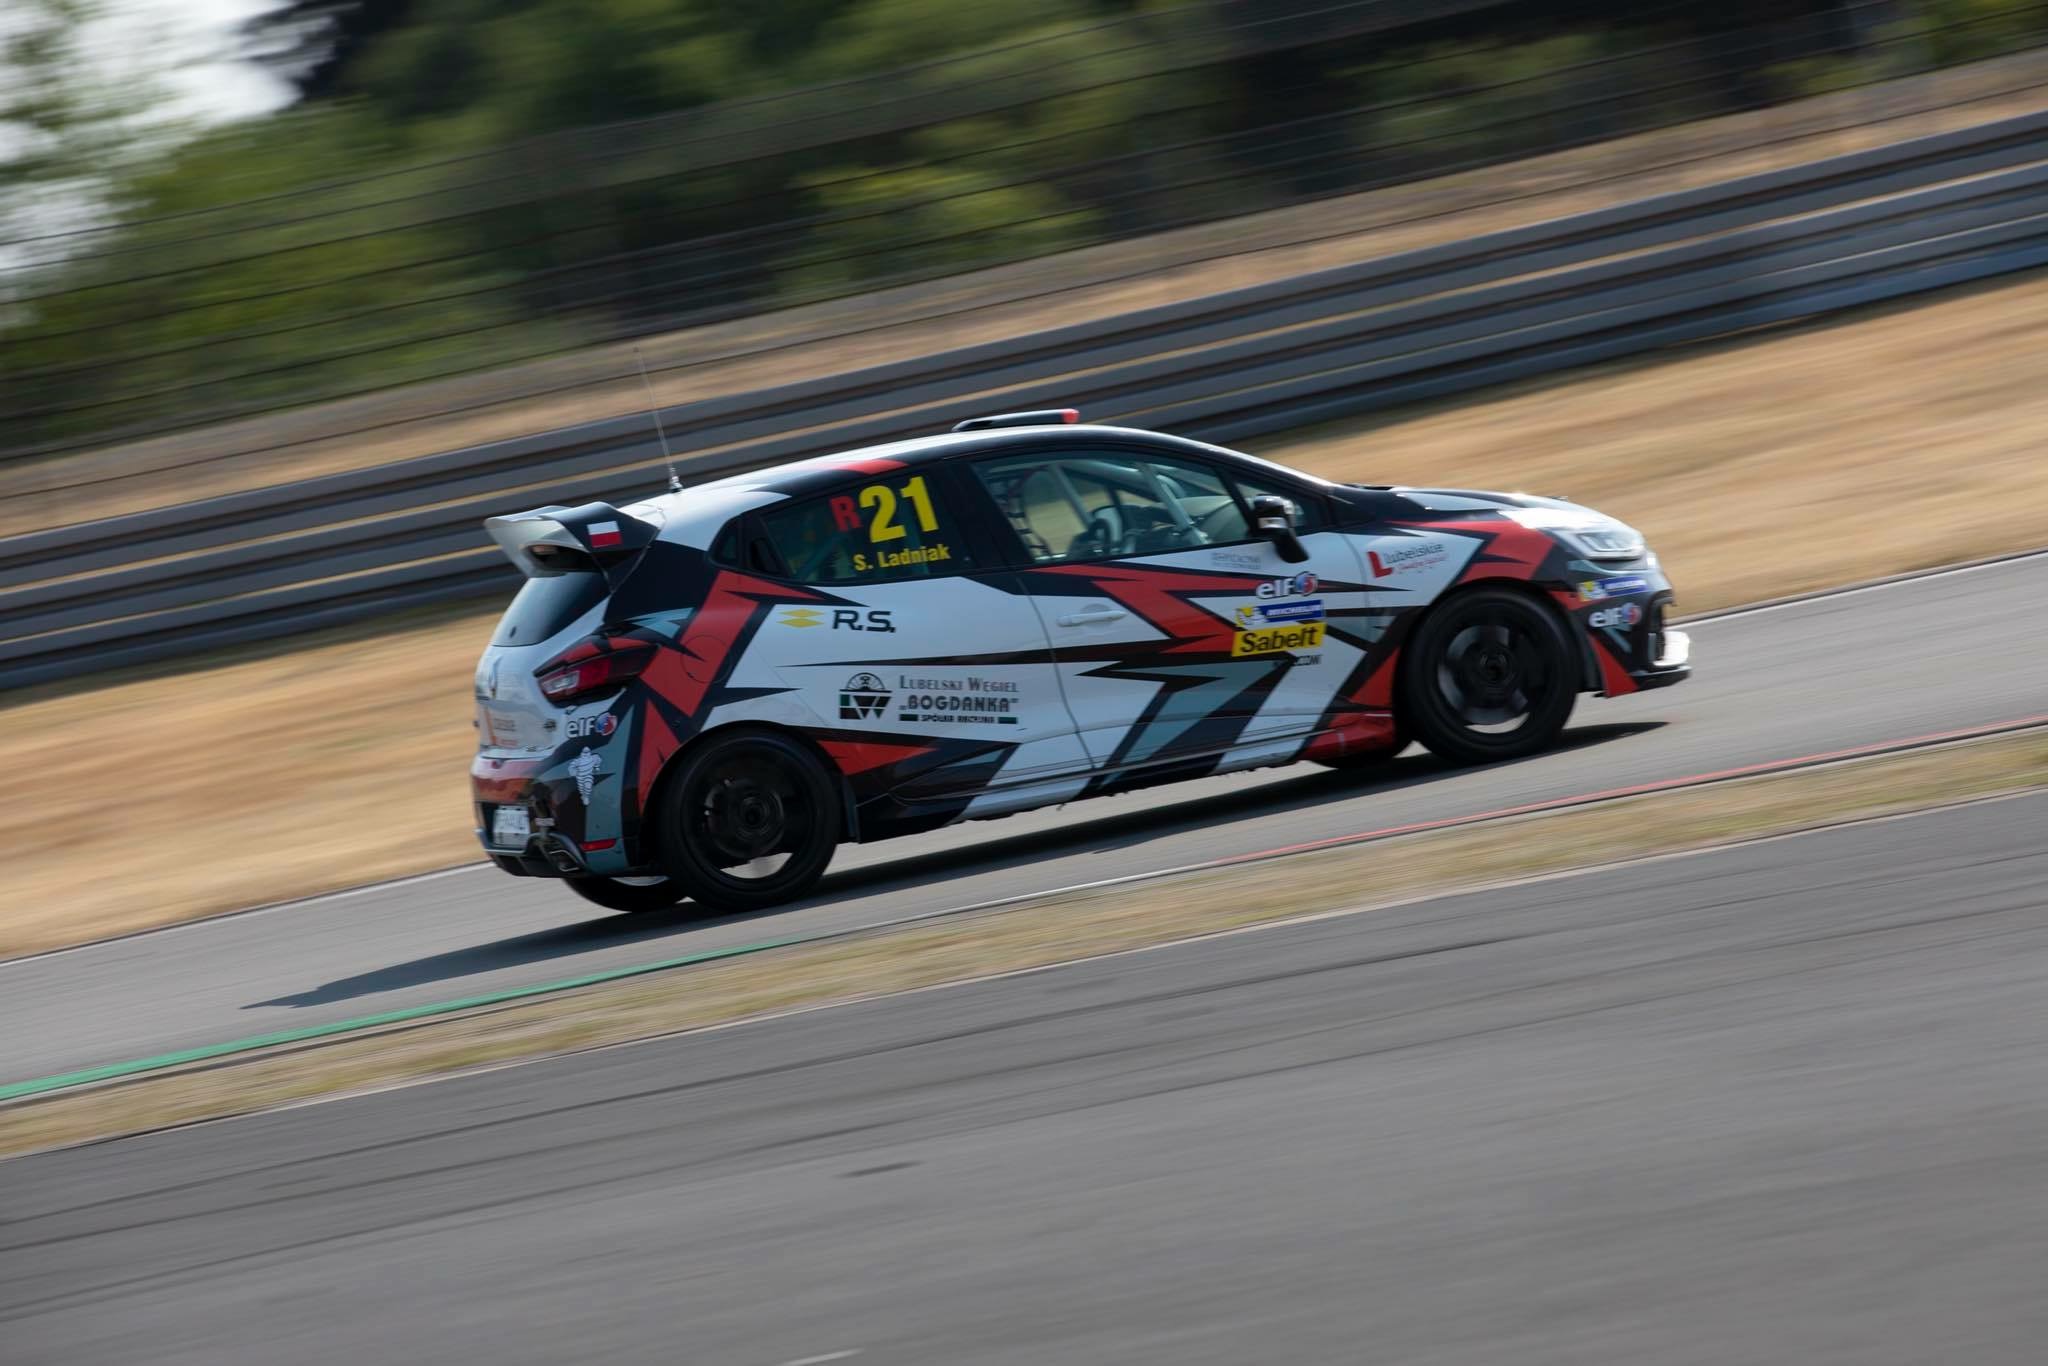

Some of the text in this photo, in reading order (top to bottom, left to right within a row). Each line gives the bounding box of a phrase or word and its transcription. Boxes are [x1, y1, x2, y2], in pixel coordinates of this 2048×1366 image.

[831, 476, 939, 543] R 21
[852, 544, 951, 571] S. Ladniak
[832, 609, 896, 633] R.S.
[1240, 626, 1317, 653] Sabelt
